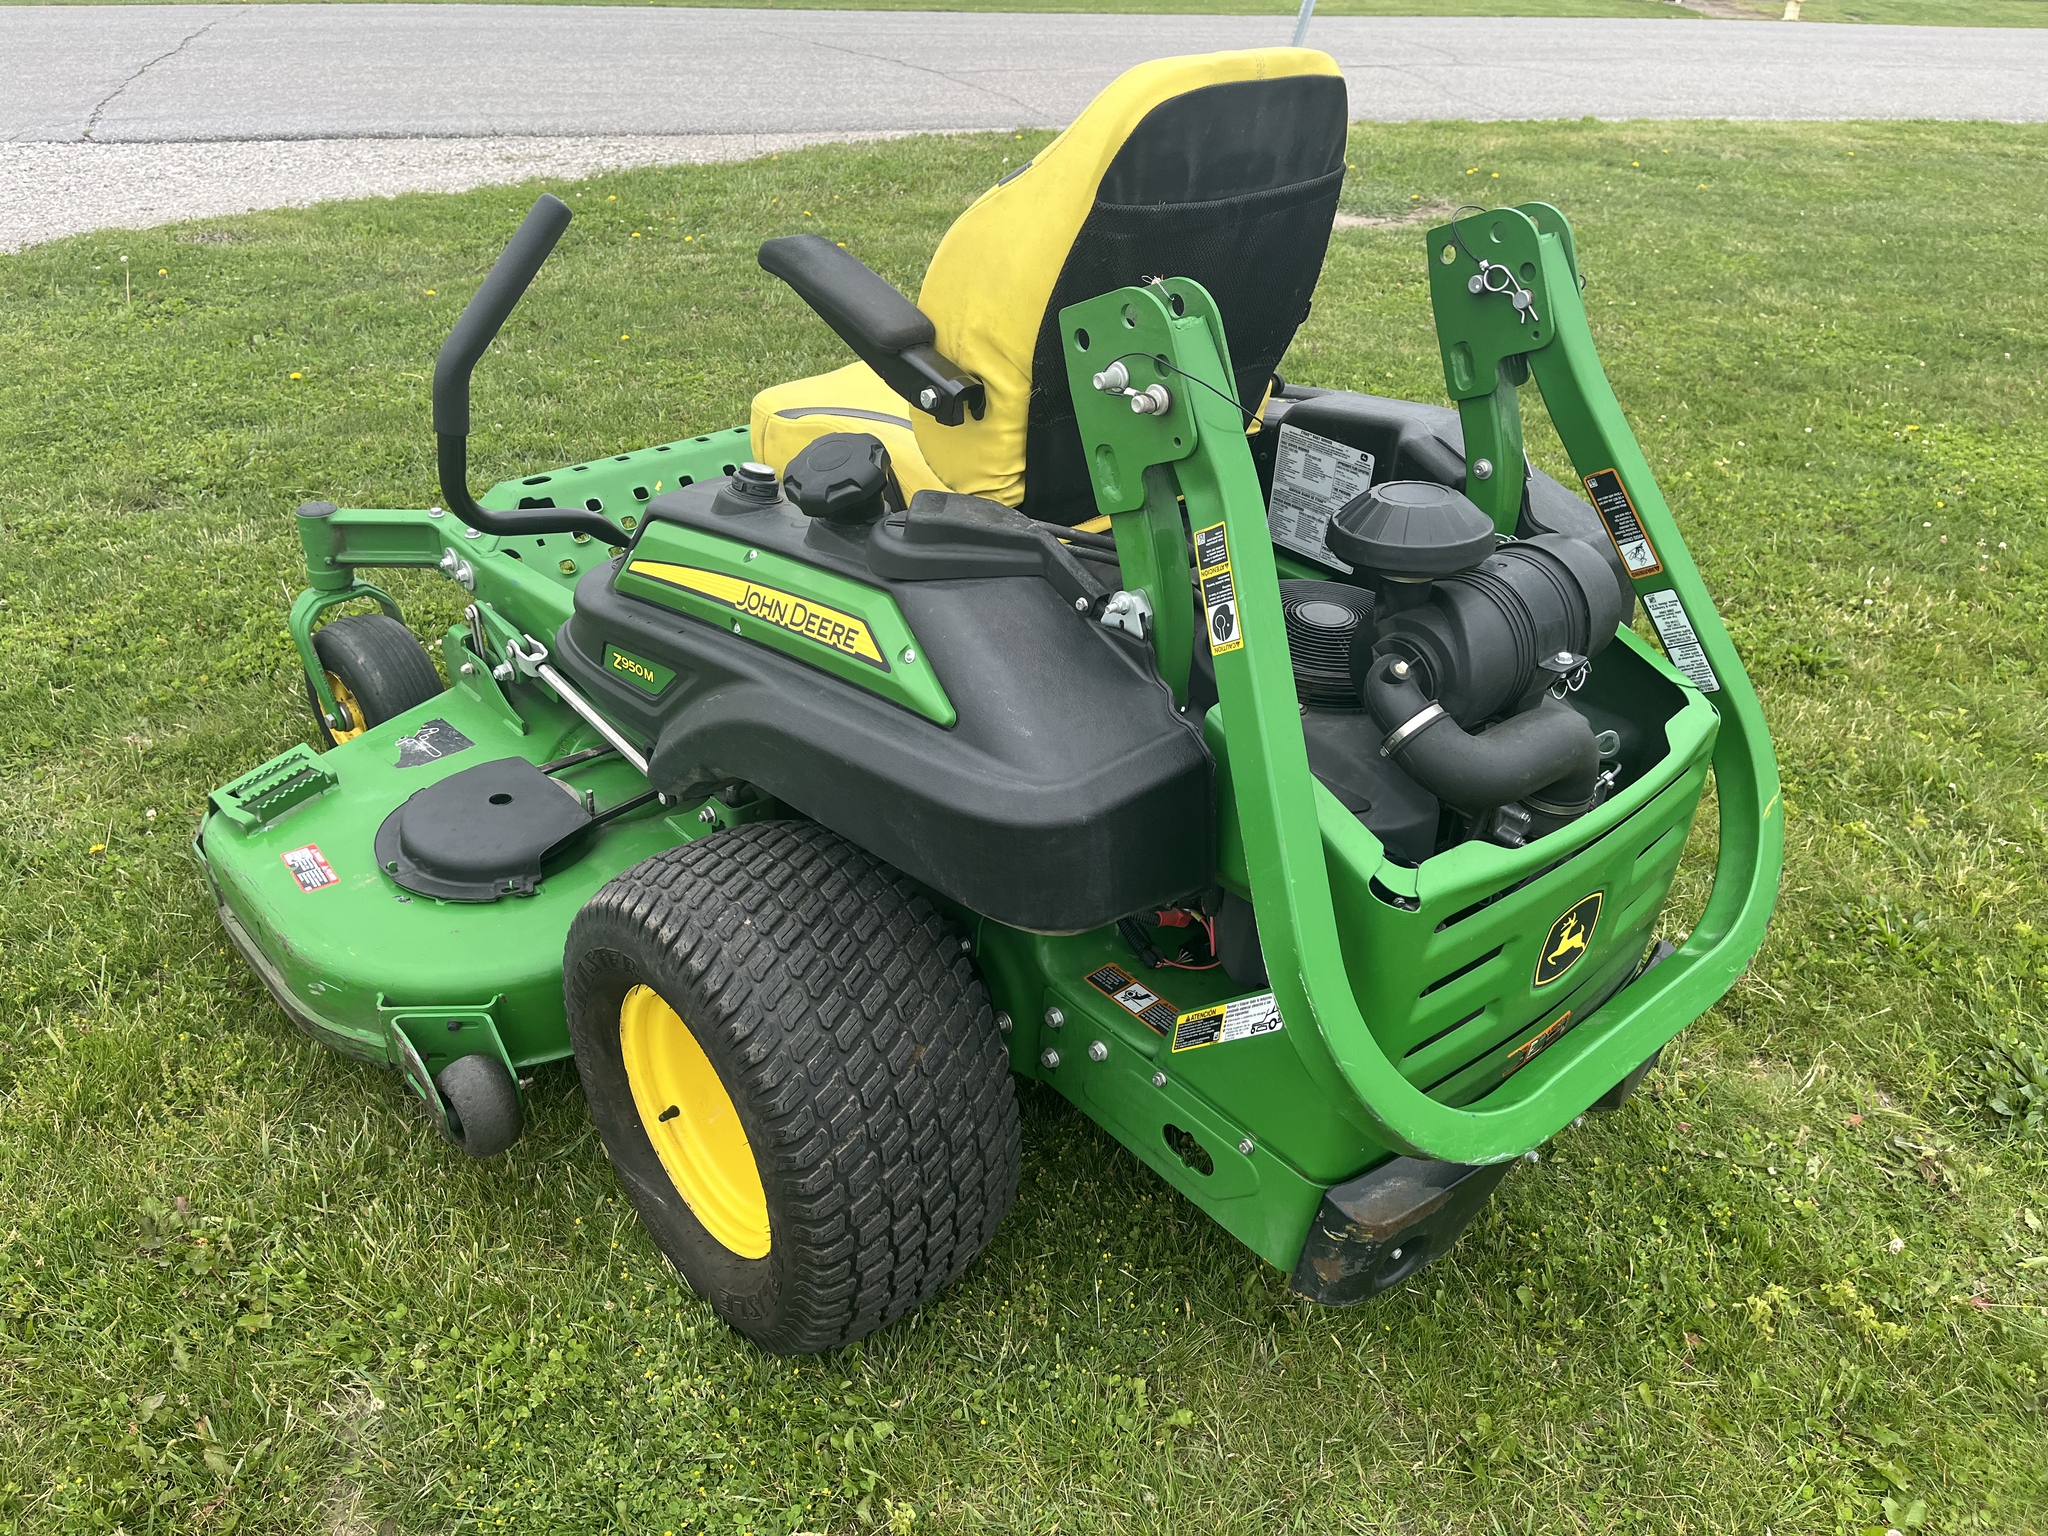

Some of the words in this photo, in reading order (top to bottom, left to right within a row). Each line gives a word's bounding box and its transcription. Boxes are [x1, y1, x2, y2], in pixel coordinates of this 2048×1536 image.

[736, 585, 788, 622] JOHN
[790, 602, 860, 651] DEERE
[1213, 640, 1236, 655] CAUTION
[612, 651, 655, 684] Z950M
[1190, 1007, 1217, 1020] ATENCIÓN
